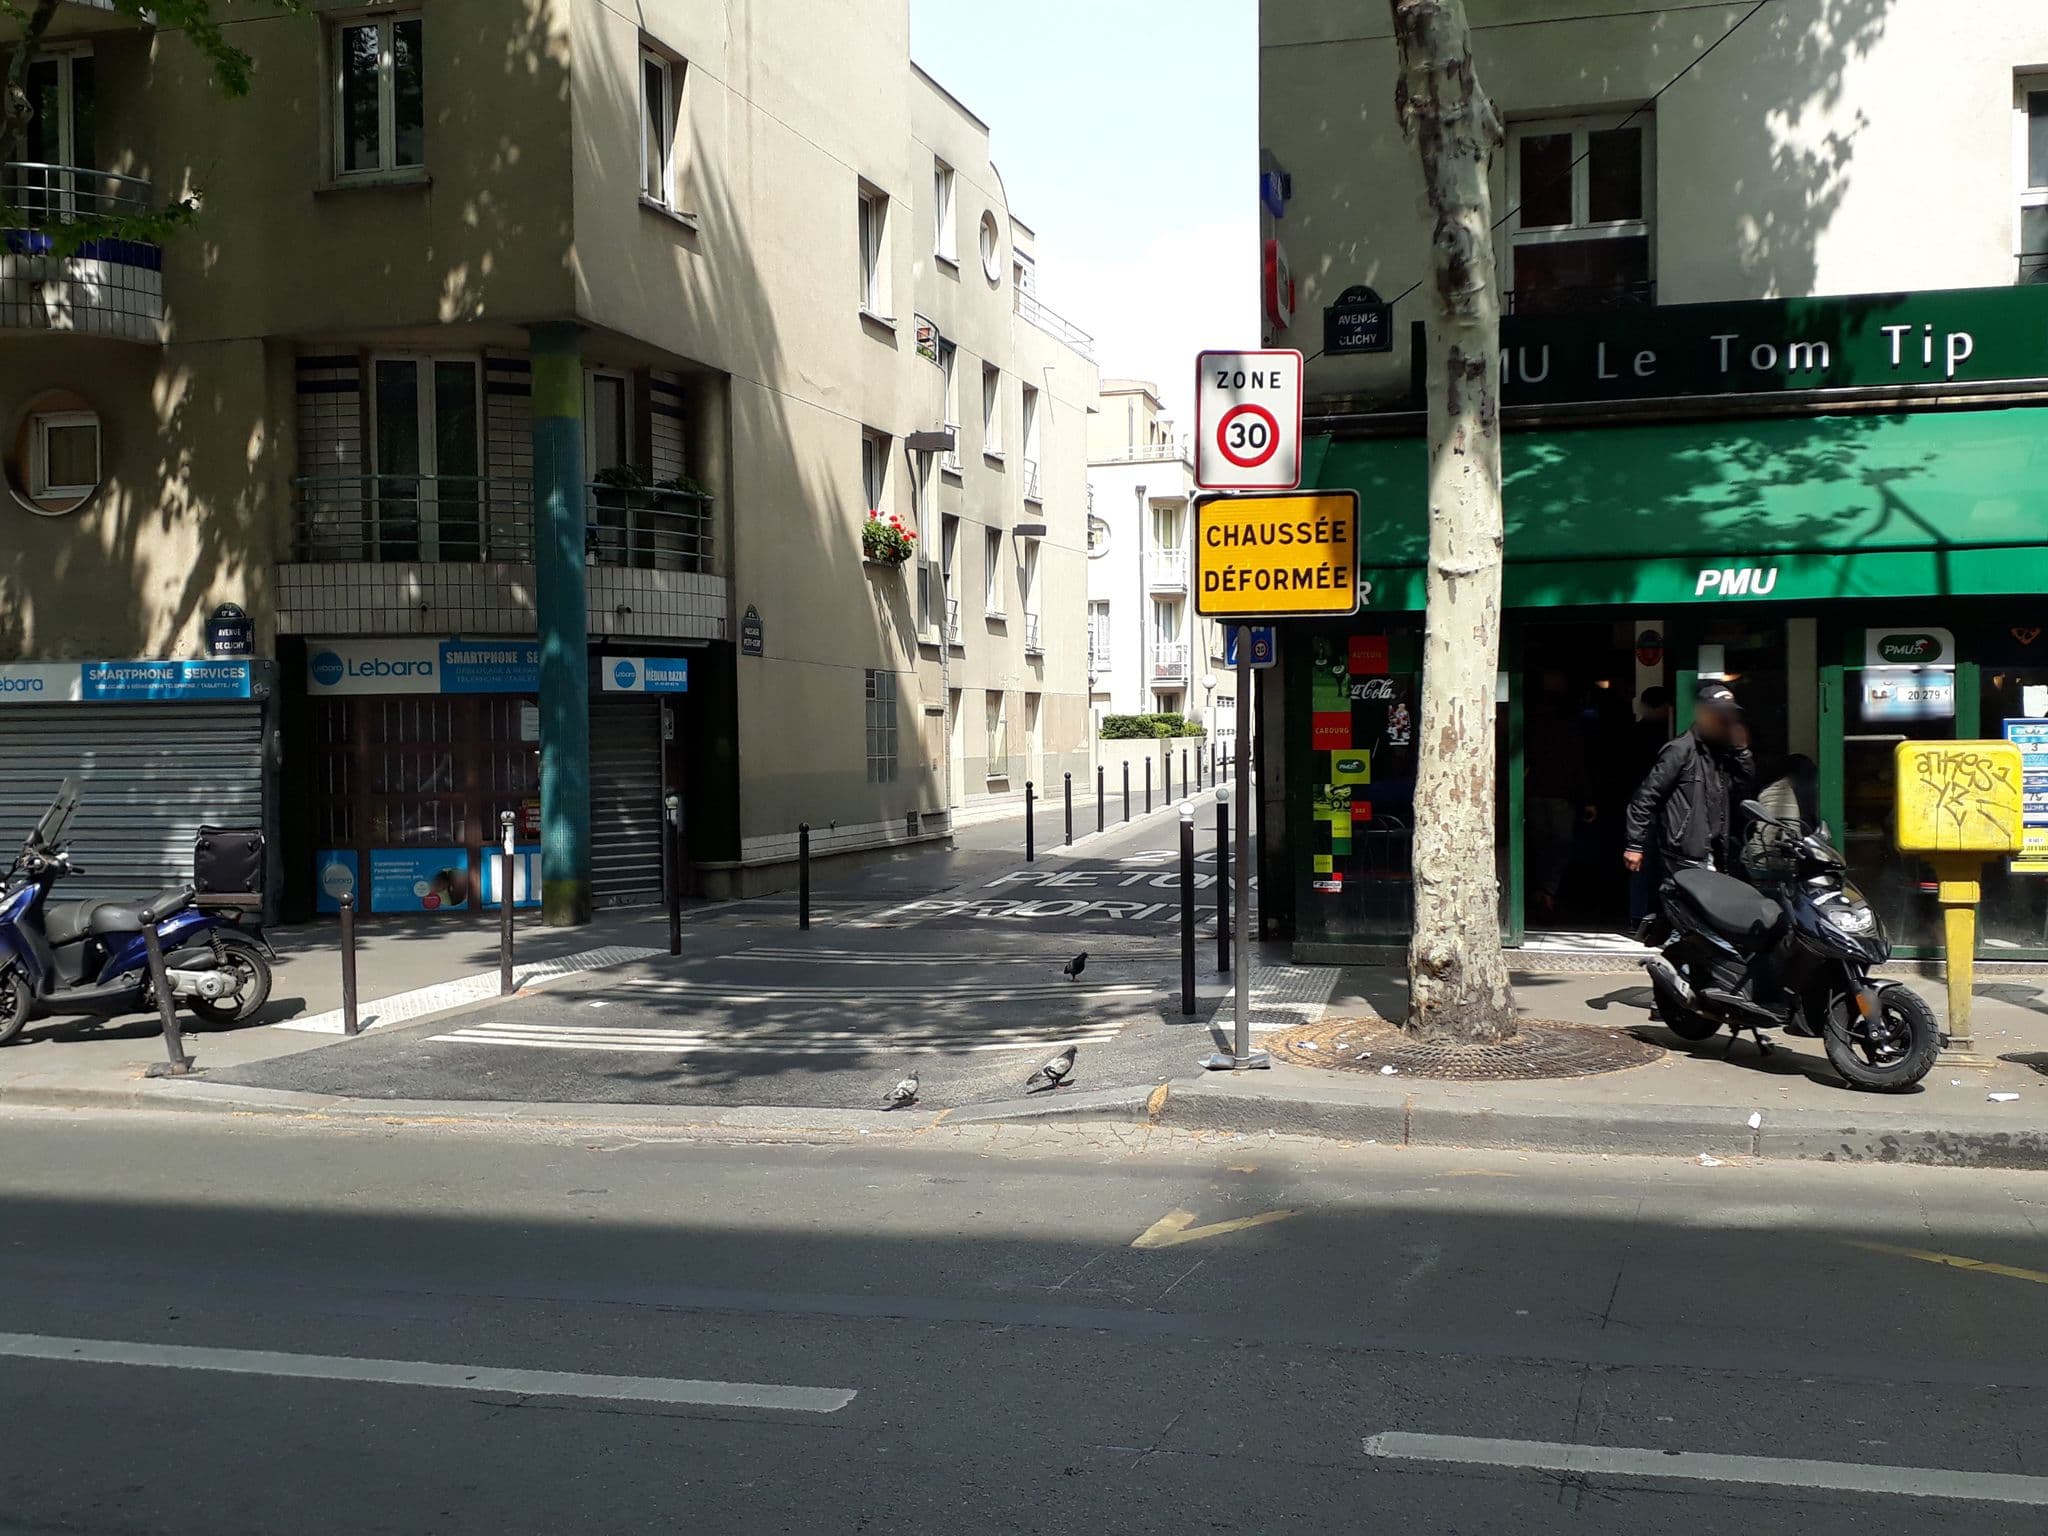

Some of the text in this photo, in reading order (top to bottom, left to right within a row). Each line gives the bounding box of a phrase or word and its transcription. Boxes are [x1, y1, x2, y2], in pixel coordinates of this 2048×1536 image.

[1338, 313, 1378, 325] AVENUE
[1339, 334, 1377, 346] CLICHY
[1597, 342, 1657, 380] Le
[1710, 334, 1830, 373] Tom
[1880, 323, 1974, 378] Tip
[1217, 371, 1281, 389] ZONE
[1230, 423, 1267, 449] 30
[1206, 516, 1347, 547] CHAUSSÉE
[1204, 562, 1348, 592] DÉFORMÉE
[1695, 567, 1777, 596] PMU
[218, 628, 241, 637] AVENUE
[446, 651, 518, 665] SMARTPHONE
[1884, 645, 1914, 655] PMU
[88, 667, 246, 680] SMARTPHONE SERVICES
[348, 657, 433, 677] Lebara
[982, 871, 1258, 889] PIETON
